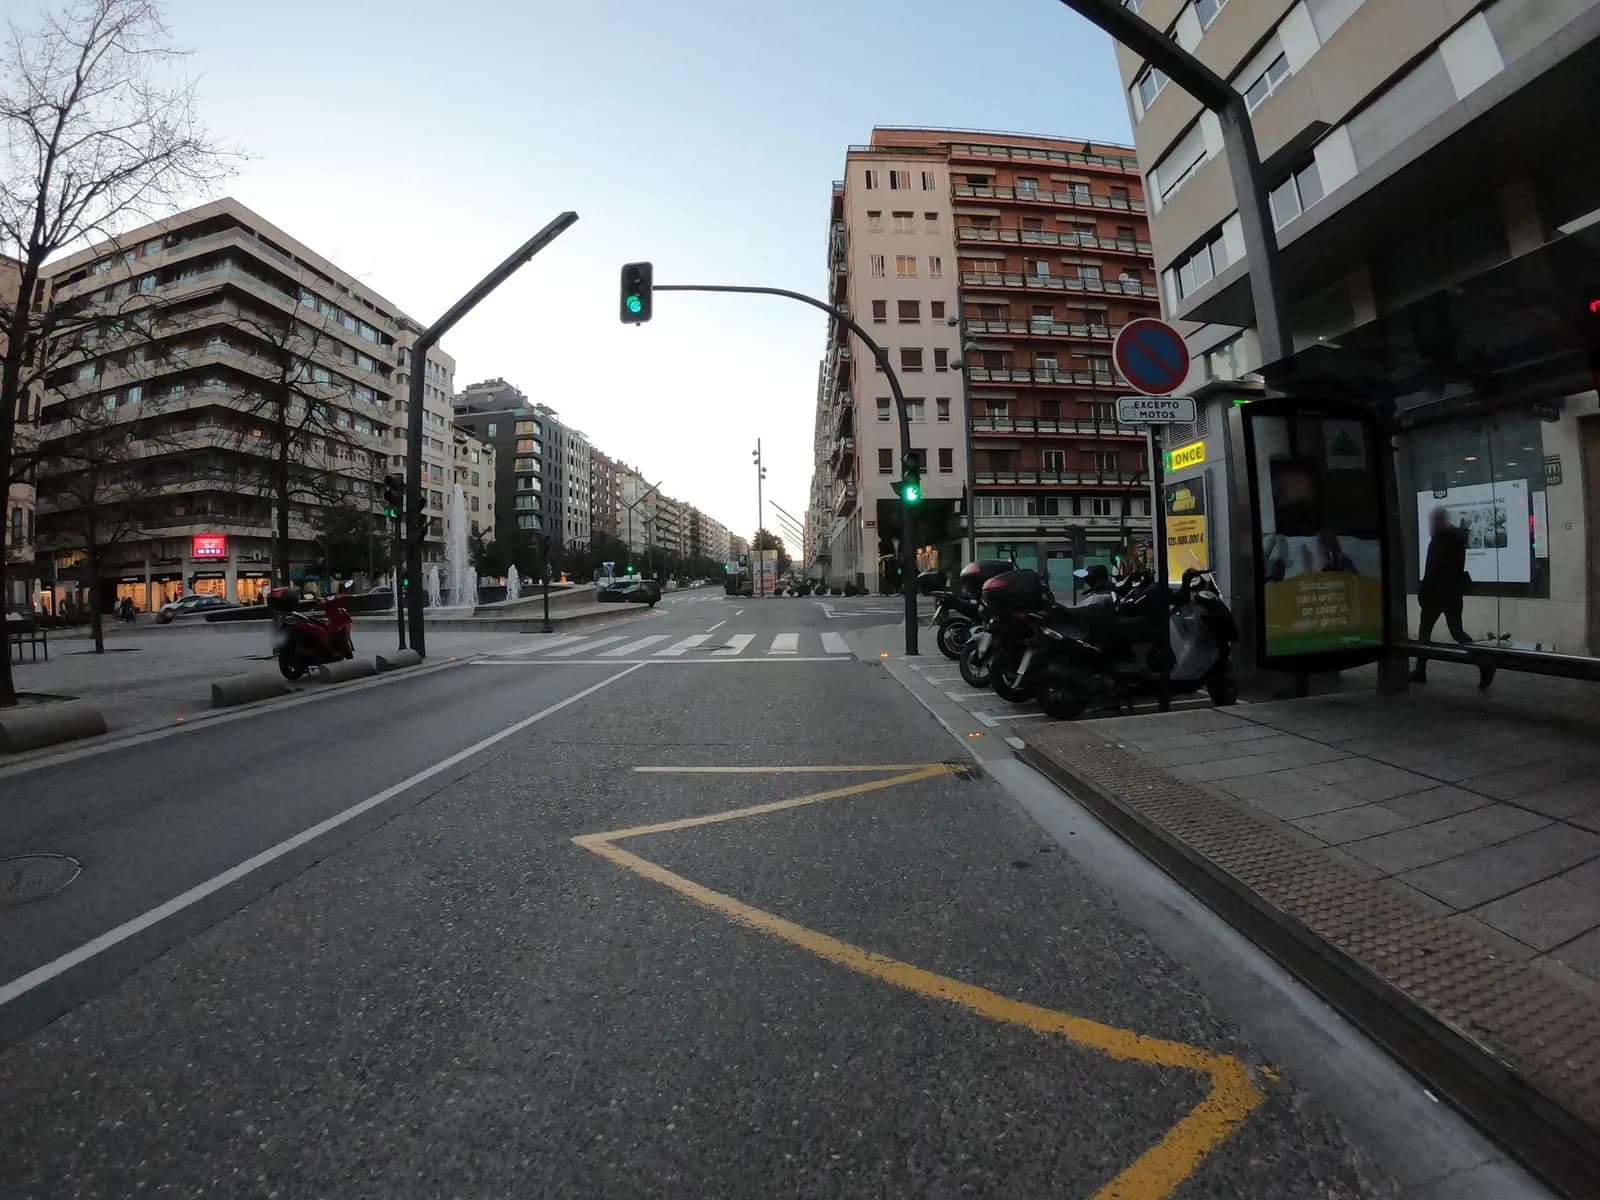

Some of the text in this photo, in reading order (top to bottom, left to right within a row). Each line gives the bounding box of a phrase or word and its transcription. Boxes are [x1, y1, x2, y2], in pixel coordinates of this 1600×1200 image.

[1134, 401, 1180, 409] EXCEPTO
[1139, 411, 1176, 419] MOTOS
[1175, 447, 1202, 465] ONCE
